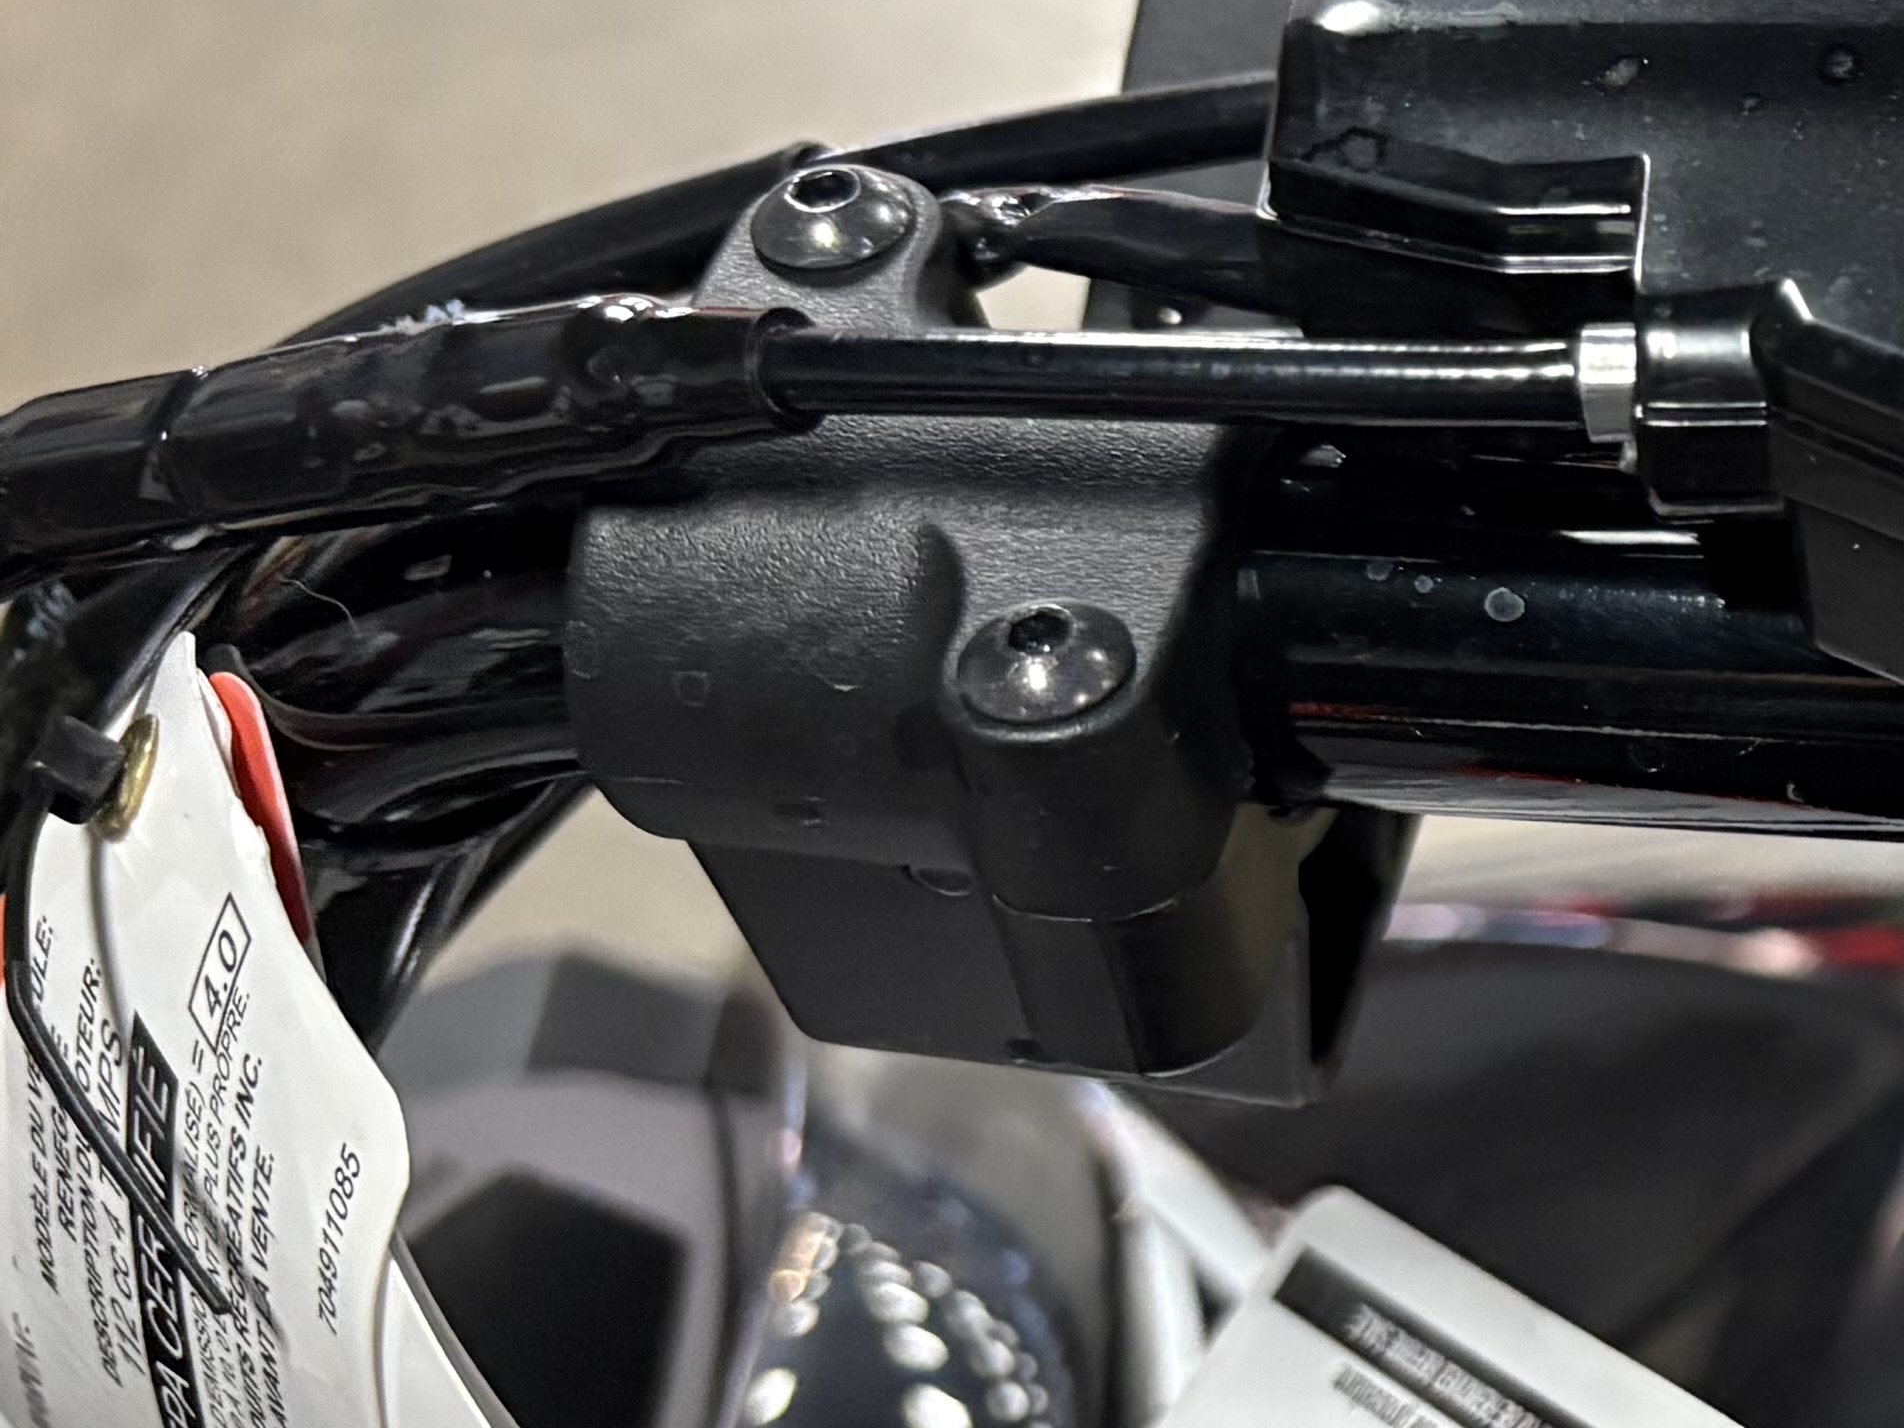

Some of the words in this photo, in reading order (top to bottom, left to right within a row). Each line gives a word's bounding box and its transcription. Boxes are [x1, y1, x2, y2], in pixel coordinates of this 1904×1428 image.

[77, 956, 101, 1093] OTEUR:
[180, 1080, 204, 1250] ORMALISÉ)
[204, 928, 241, 1017] 4.0
[30, 1098, 45, 1153] DU
[52, 1024, 76, 1241] RENEGE
[98, 1018, 126, 1197] TMPS
[232, 1052, 262, 1129] INC.
[100, 1200, 126, 1240] 4
[135, 1044, 181, 1359] CERIFIÉ
[201, 1122, 222, 1204] PLUS
[250, 1144, 273, 1270] VENTE.
[77, 1173, 120, 1385] DESCRIPTION
[112, 1244, 131, 1300] CC
[317, 1142, 361, 1335] 704911085
[111, 1296, 145, 1374] 112
